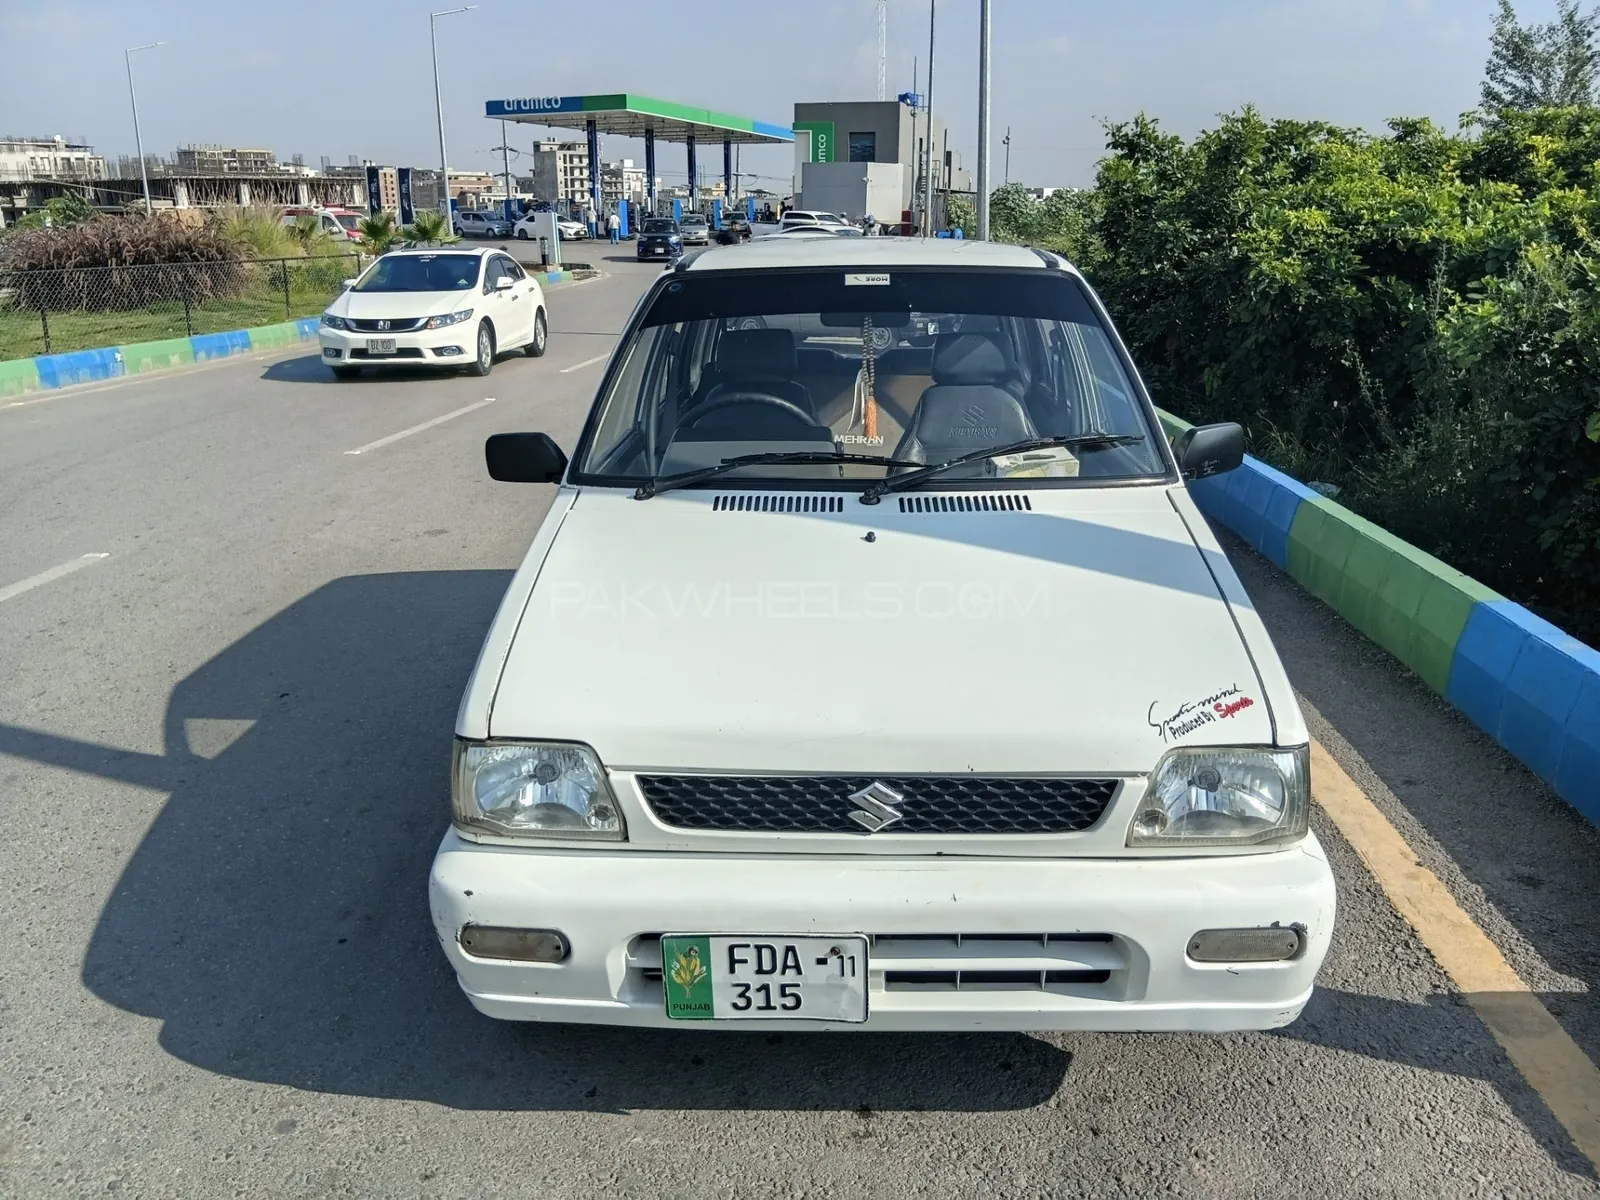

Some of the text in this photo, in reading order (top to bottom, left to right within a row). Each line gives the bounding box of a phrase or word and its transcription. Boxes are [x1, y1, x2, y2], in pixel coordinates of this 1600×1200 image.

[504, 96, 561, 111] aramco
[834, 434, 884, 444] MEHRAN
[1168, 713, 1205, 740] Produced
[1201, 711, 1216, 722] By
[728, 943, 803, 976] FDA
[673, 1002, 711, 1011] PUNJAB
[732, 983, 803, 1011] 315
